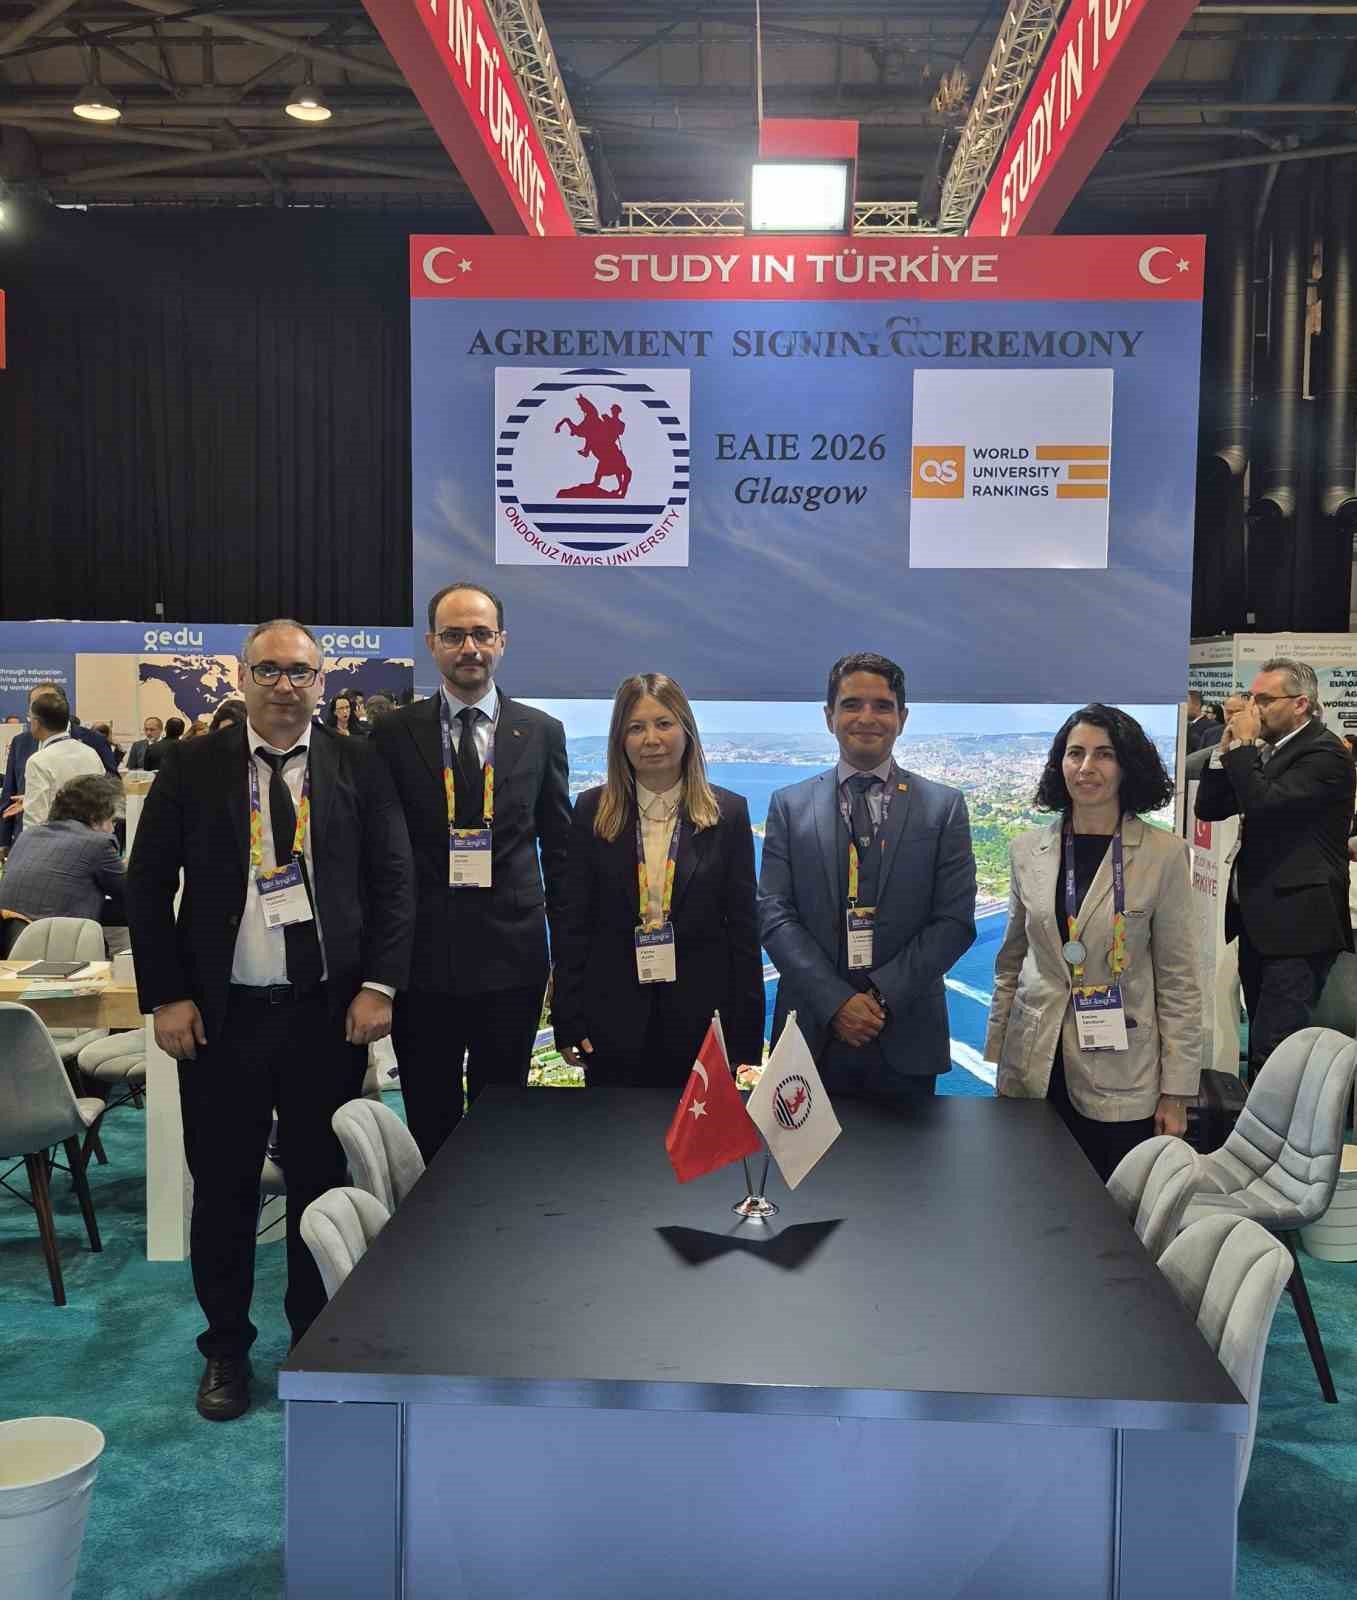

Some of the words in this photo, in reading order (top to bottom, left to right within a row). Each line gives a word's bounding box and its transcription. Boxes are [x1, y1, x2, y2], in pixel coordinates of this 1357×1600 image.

[476, 24, 545, 236] TÜRKİYE
[1000, 72, 1057, 236] STUDY
[1060, 17, 1083, 131] IN
[593, 254, 740, 283] STUDY
[751, 254, 795, 283] IN
[806, 246, 998, 283] TÜRKİYE
[466, 328, 713, 357] AGREEMENT
[715, 434, 800, 461] EAIE
[810, 434, 887, 461] 2026
[973, 448, 1029, 460] WORLD
[919, 459, 958, 486] QS
[973, 466, 1060, 478] UNIVERSITY
[735, 477, 868, 511] Glasgow
[972, 485, 1049, 497] RANKINGS
[505, 506, 559, 560] ONDOKUZ
[607, 509, 680, 565] UNIVERSITY
